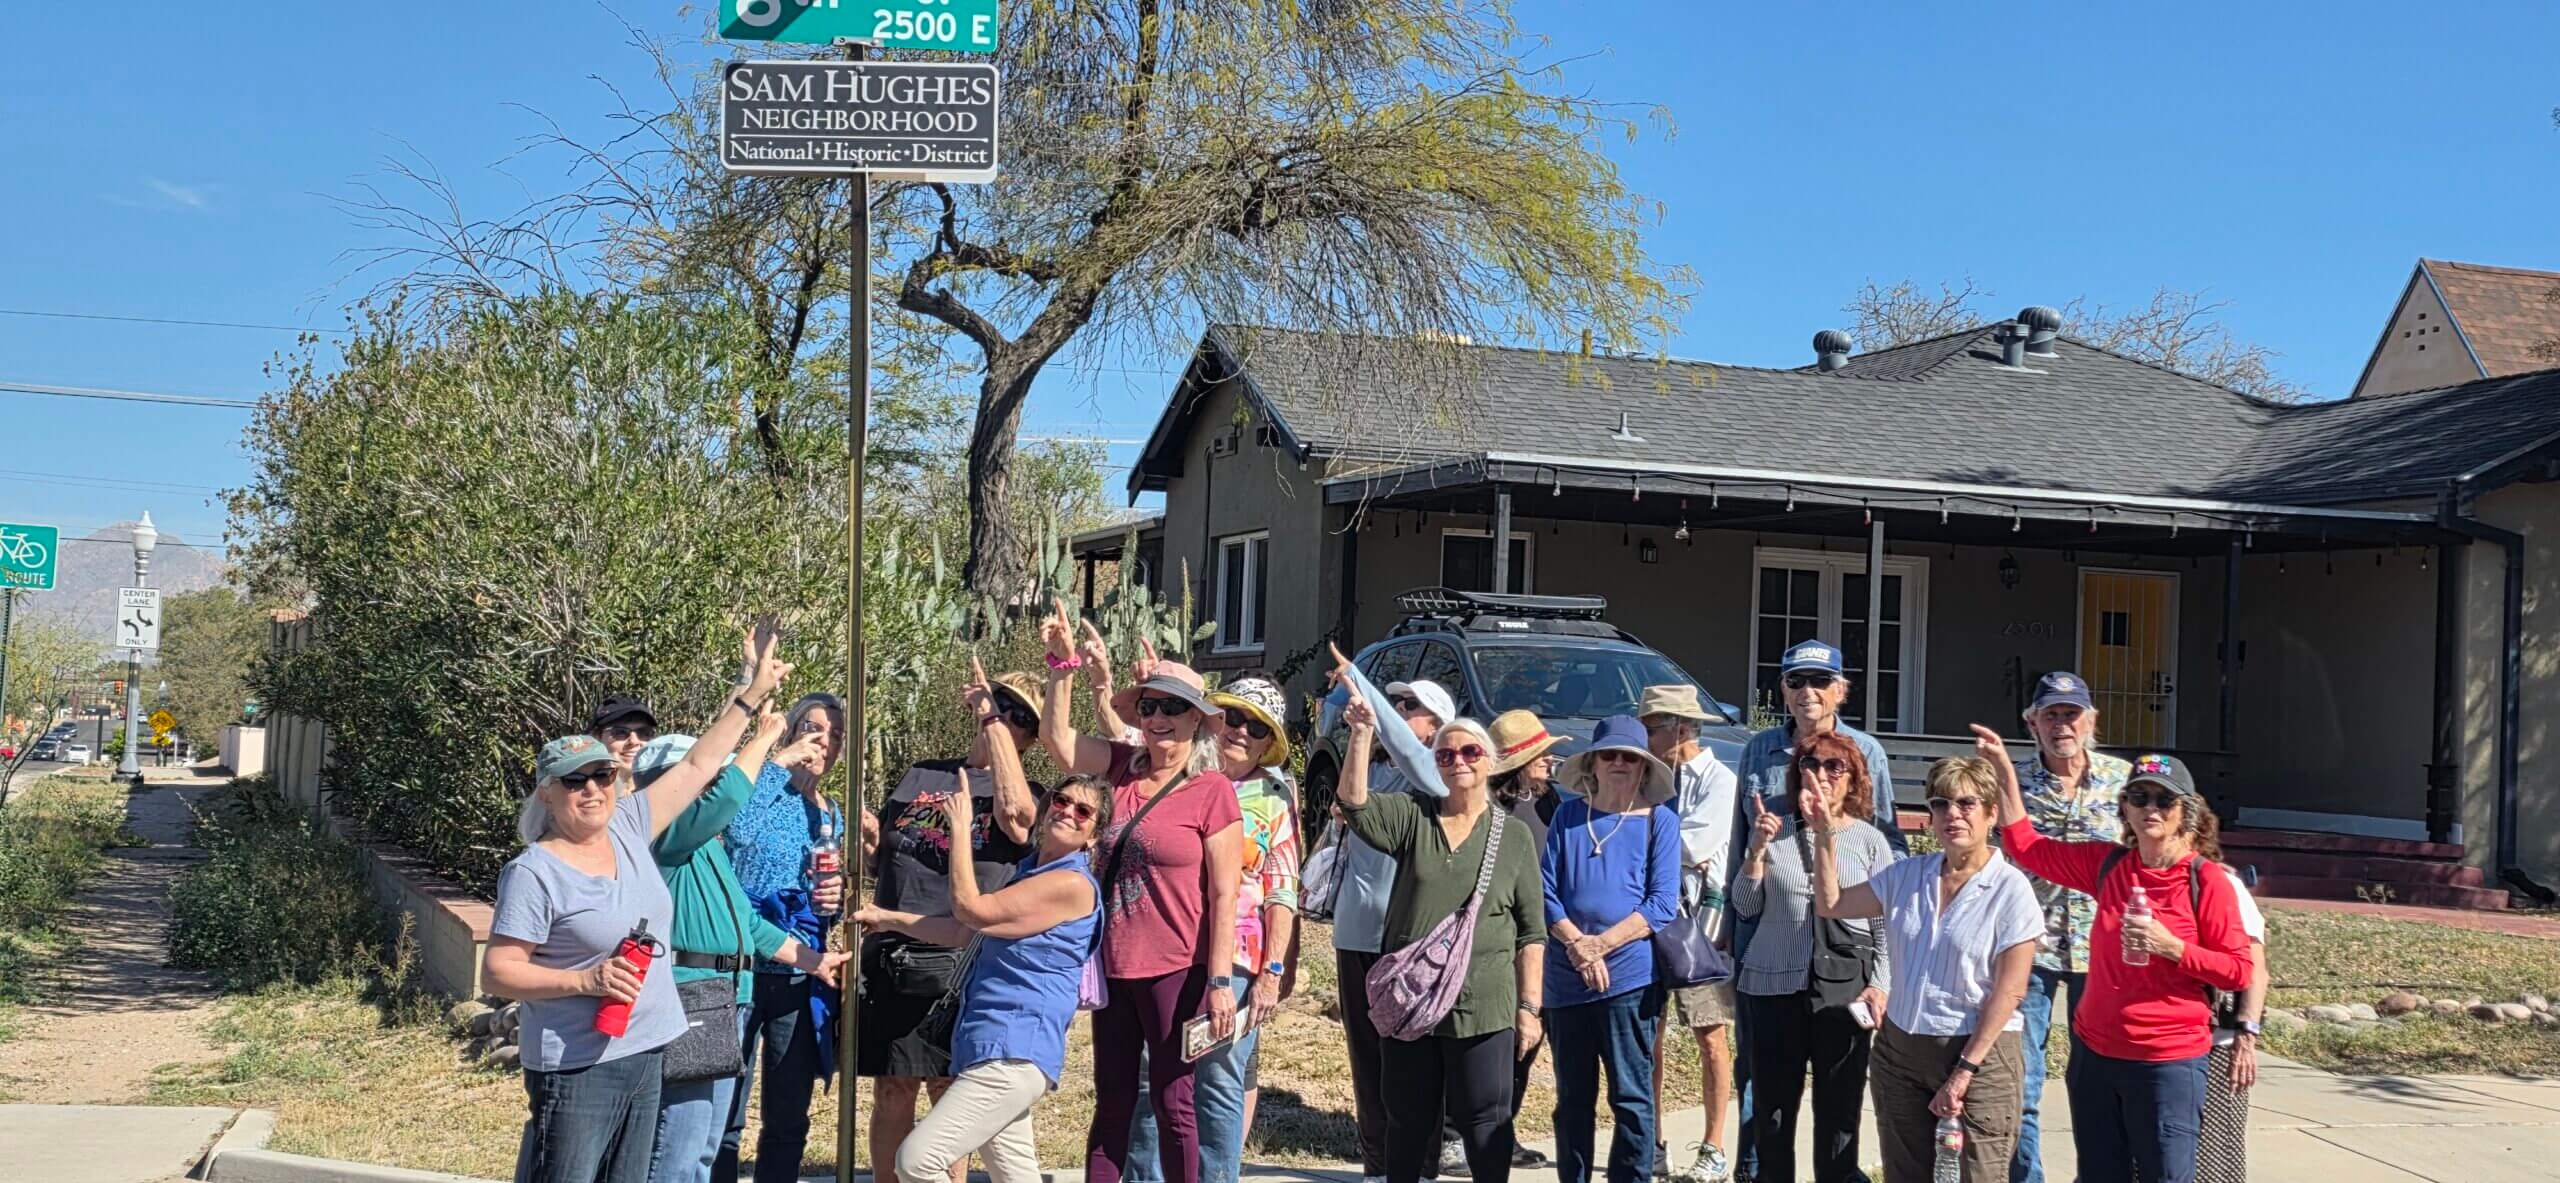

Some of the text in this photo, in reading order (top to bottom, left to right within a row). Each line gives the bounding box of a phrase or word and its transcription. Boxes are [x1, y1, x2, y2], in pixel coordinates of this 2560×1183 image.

[873, 8, 957, 42] 2500
[972, 14, 991, 45] E
[741, 108, 978, 133] NEIGHBORHOOD
[6, 570, 48, 586] ROUTE
[123, 590, 156, 598] CENTER
[127, 598, 151, 606] LANE
[125, 638, 149, 646] ONLY
